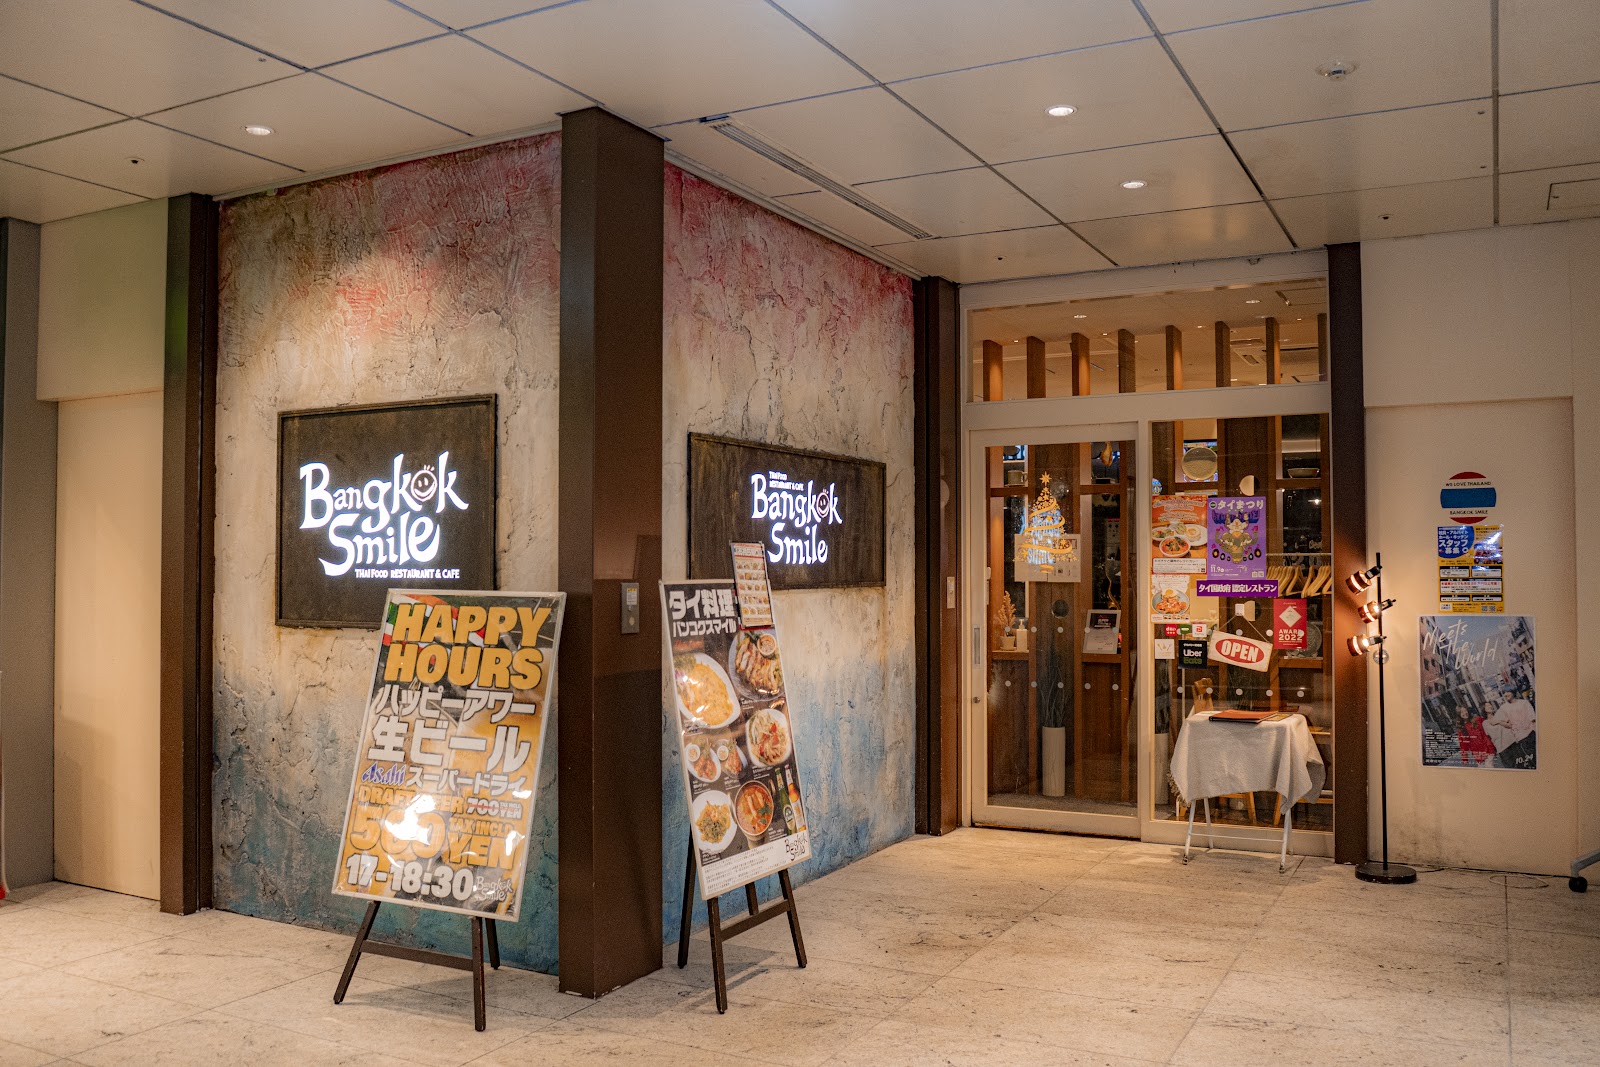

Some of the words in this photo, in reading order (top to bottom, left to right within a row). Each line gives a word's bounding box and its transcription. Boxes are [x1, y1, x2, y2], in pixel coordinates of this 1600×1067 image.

[299, 451, 469, 534] Bangkok
[751, 473, 843, 527] Bangkok
[318, 511, 440, 577] Smile
[767, 522, 828, 565] Smile
[1439, 539, 1469, 547] スタッフ
[355, 569, 370, 578] THAI
[371, 569, 388, 578] FOOD
[390, 569, 434, 578] RESTAURANT
[435, 569, 441, 578] &
[442, 569, 460, 578] CAFE
[669, 588, 736, 620] タイ料理
[392, 603, 552, 647] HAPPY
[1423, 619, 1468, 655] Meets
[384, 643, 543, 690] HOURS
[1183, 648, 1203, 657] Uber
[1184, 657, 1203, 665] Eats
[1221, 640, 1259, 663] OPEN
[1455, 637, 1498, 670] World
[375, 684, 536, 723] ハッピーアワー
[367, 715, 531, 773] 生ビール
[361, 762, 406, 786] Asahi
[406, 765, 527, 796] スーパードライ
[358, 785, 415, 807] DRAFT
[414, 793, 464, 815] EER
[466, 797, 500, 817] 700
[500, 808, 521, 820] YEN
[448, 831, 520, 869] YEN
[346, 853, 474, 901] 17-18:30
